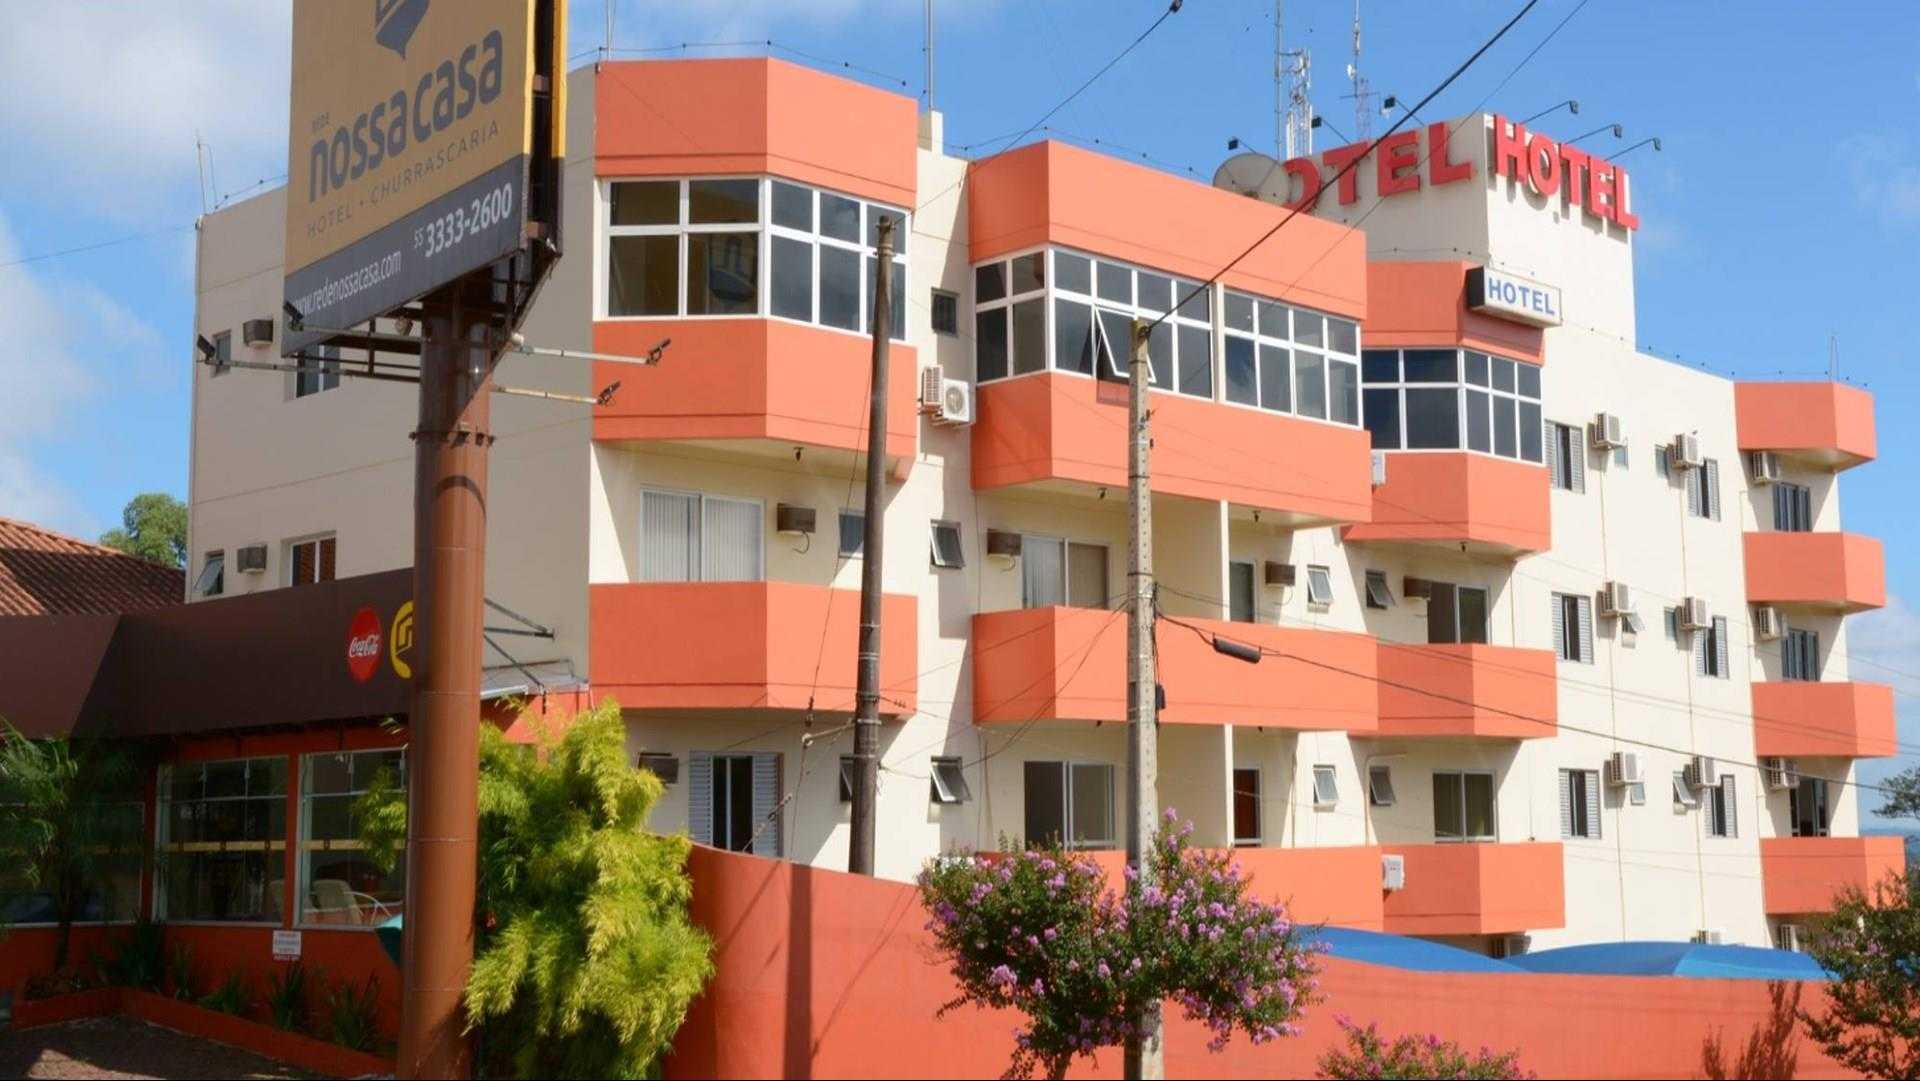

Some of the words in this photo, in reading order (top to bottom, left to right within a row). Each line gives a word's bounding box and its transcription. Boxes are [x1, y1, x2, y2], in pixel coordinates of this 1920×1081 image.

[306, 202, 352, 239] HOTEL
[369, 119, 499, 205] CHURRASCARIA
[1283, 121, 1472, 213] OTEL
[1494, 113, 1640, 231] HOTEL
[425, 182, 513, 258] 3333-2600
[1487, 276, 1556, 317] HOTEL
